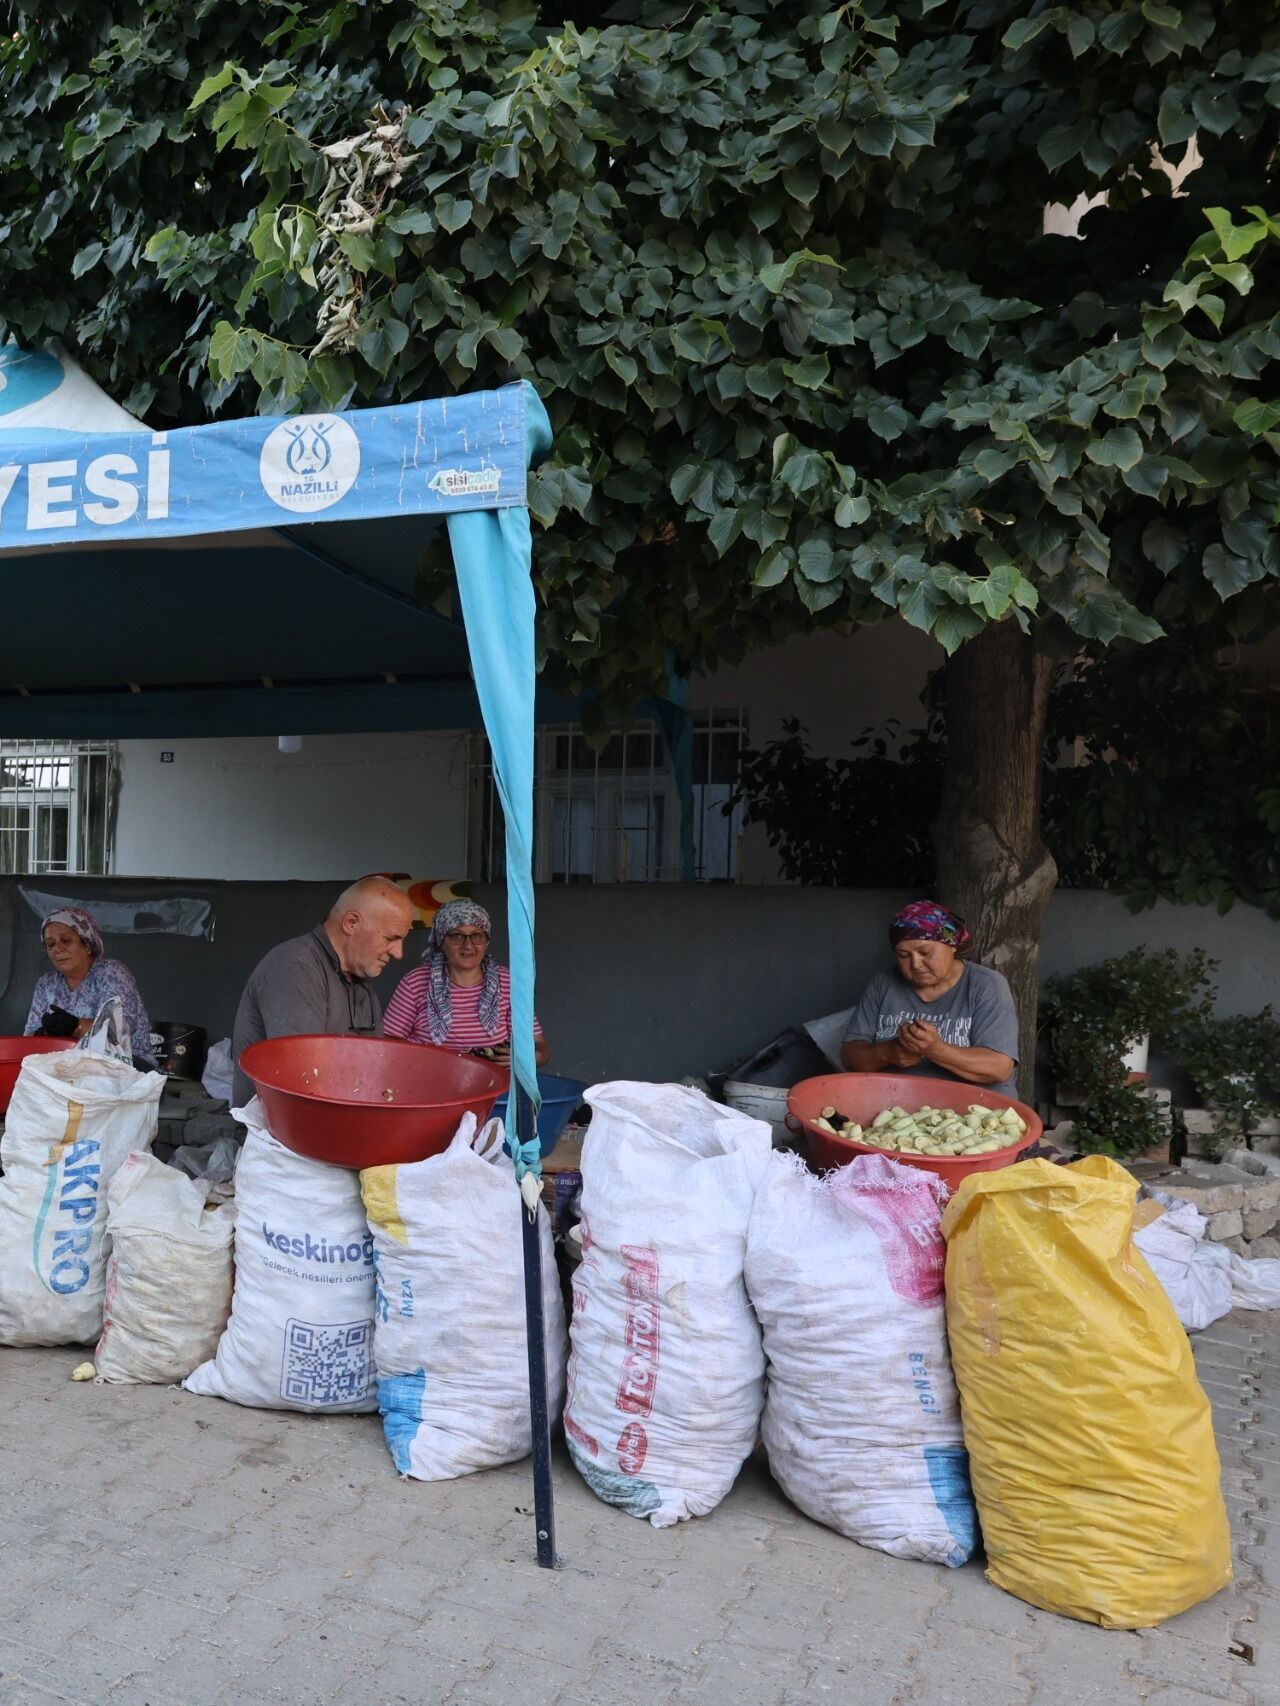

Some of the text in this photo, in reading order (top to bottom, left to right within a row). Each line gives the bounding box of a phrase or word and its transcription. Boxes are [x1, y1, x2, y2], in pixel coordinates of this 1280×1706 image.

[281, 481, 338, 497] NAZİLLİ
[49, 1138, 101, 1295] AKPRO
[399, 1279, 414, 1318] İMZA
[624, 1302, 654, 1399] TONTON
[909, 1352, 942, 1414] BENGİ
